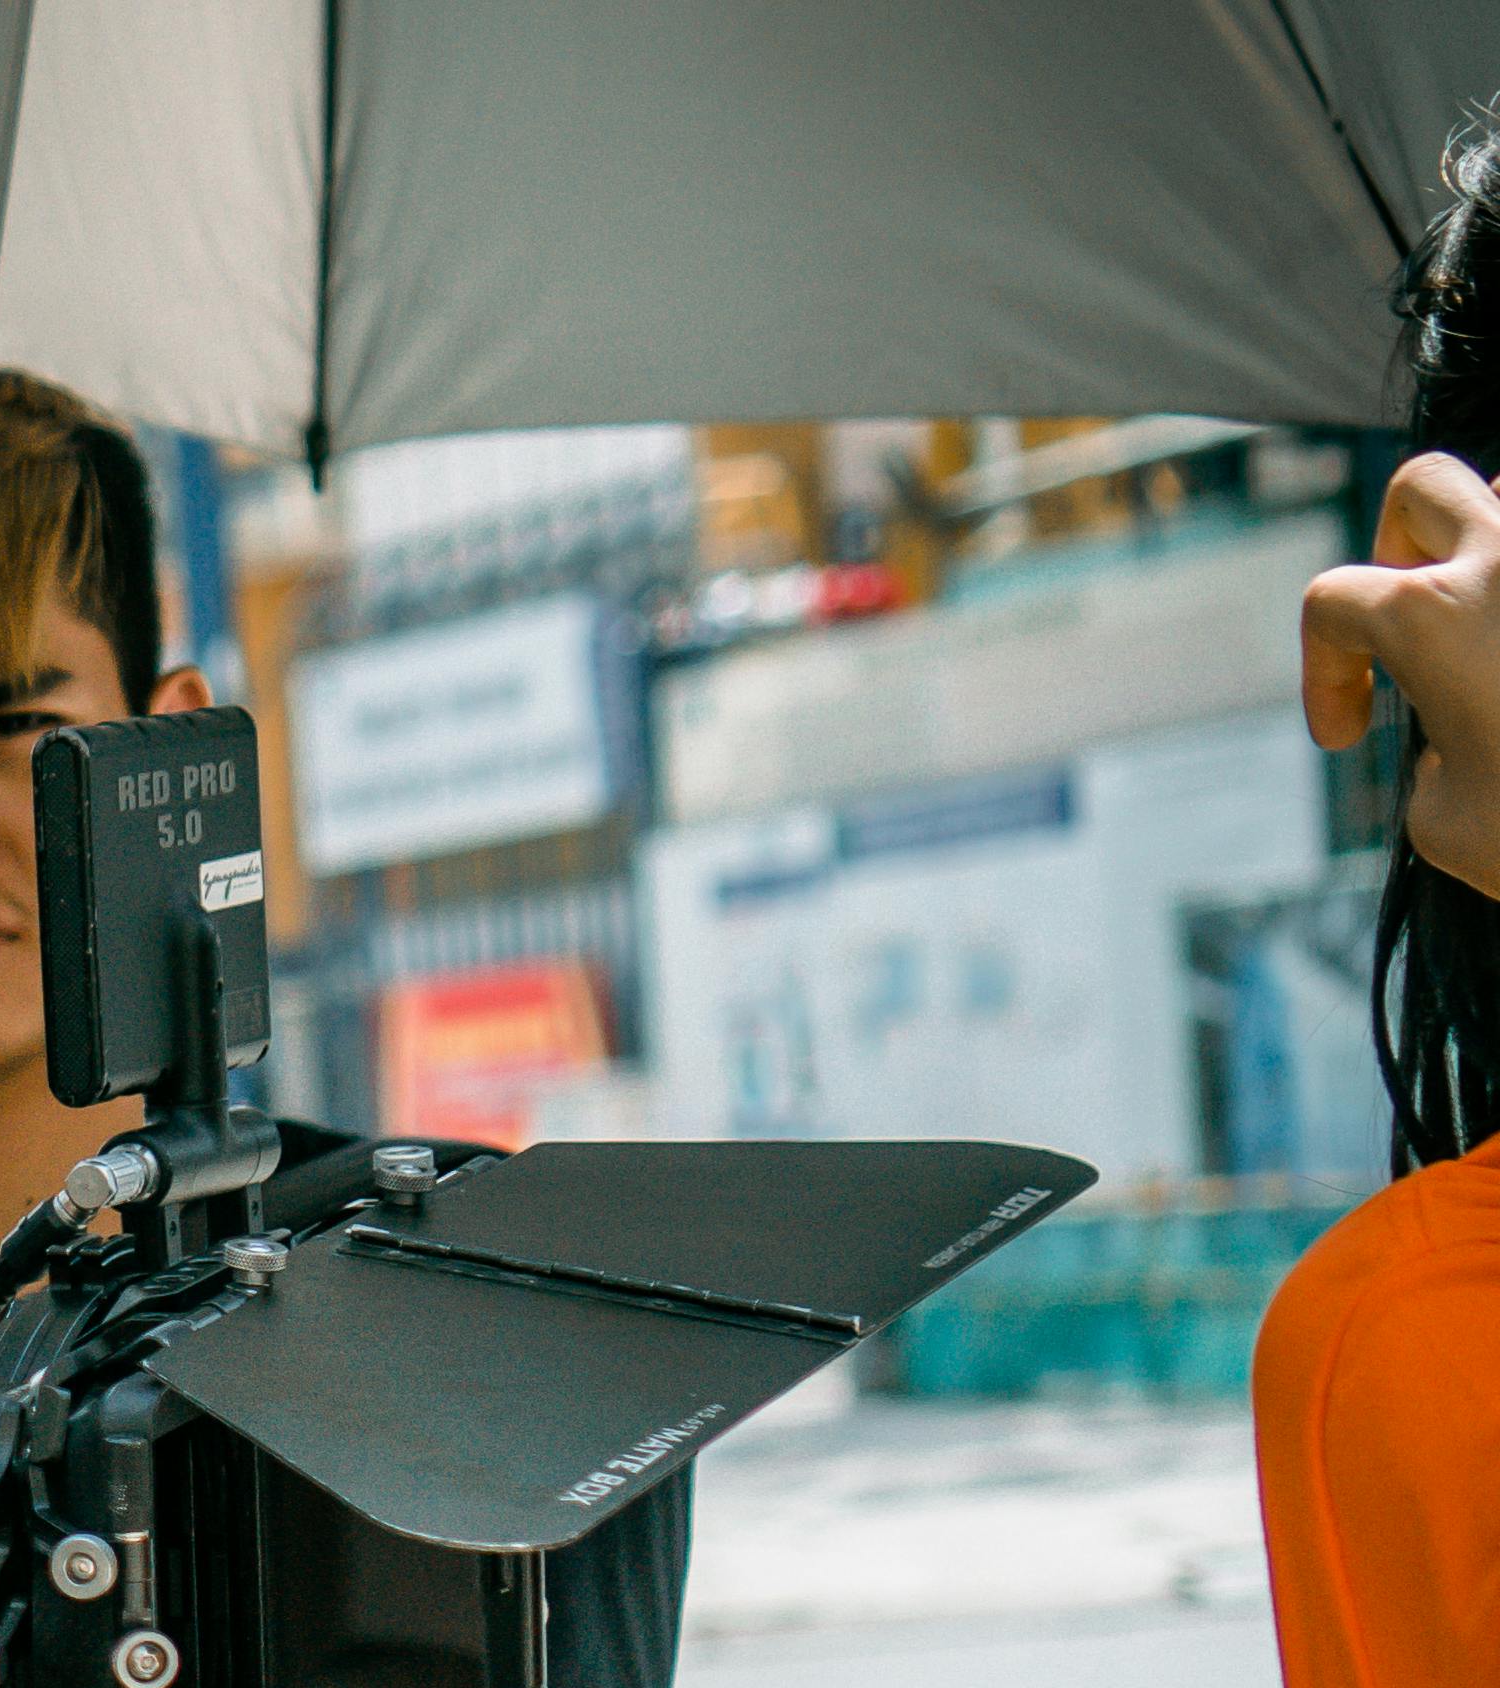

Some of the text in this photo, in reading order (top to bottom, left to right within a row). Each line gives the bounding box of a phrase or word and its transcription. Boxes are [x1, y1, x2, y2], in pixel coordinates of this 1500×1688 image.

[118, 760, 236, 812] RED PRO
[158, 808, 203, 849] 5.0
[607, 1426, 693, 1474] MATTE
[559, 1471, 628, 1507] BOX
